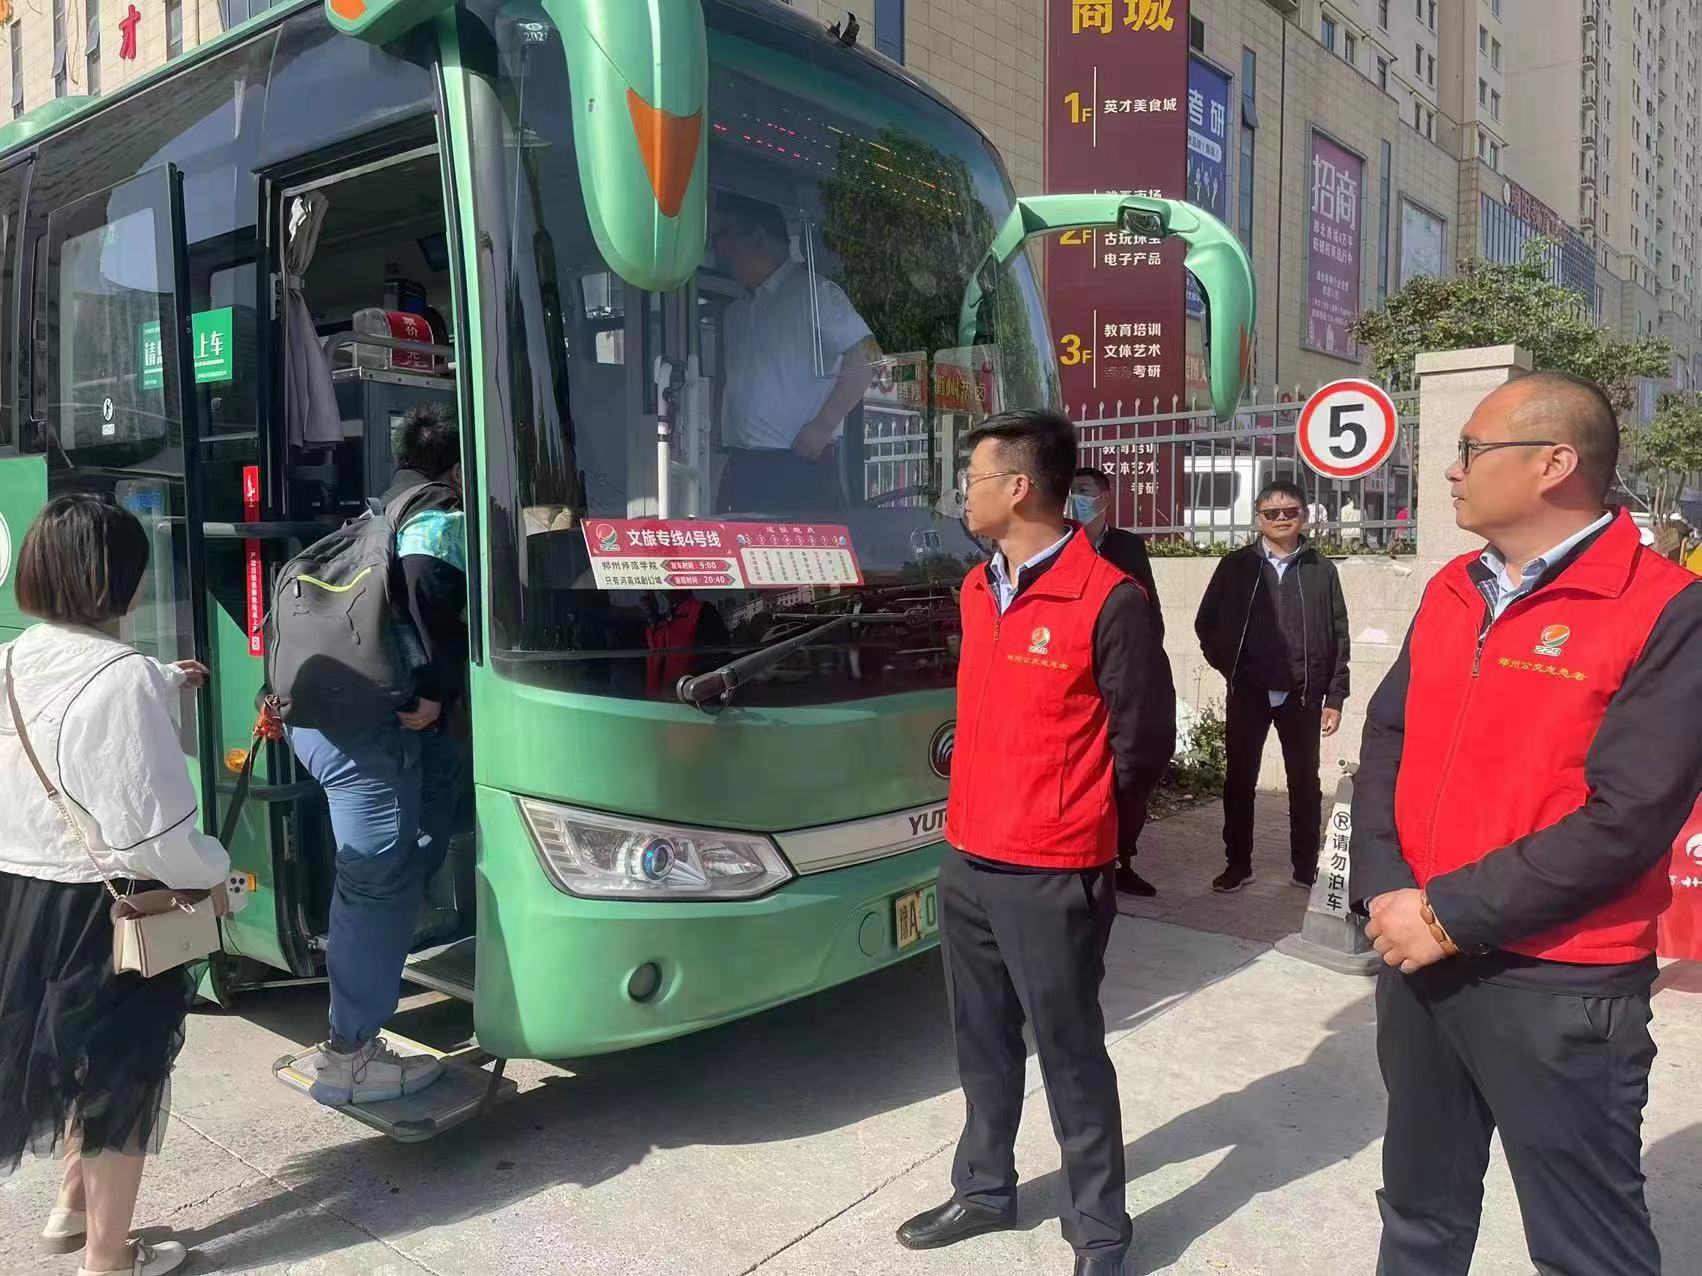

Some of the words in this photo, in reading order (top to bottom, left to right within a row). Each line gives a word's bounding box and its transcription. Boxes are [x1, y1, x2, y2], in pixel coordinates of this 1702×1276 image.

[1072, 0, 1174, 34] 商城
[1104, 97, 1177, 114] 英才美食城
[1312, 153, 1357, 231] 招商
[1104, 252, 1162, 266] 电子产品
[1104, 323, 1162, 337] 教育培训
[197, 330, 224, 359] 上车
[1104, 344, 1162, 358] 文体艺术
[1133, 365, 1161, 379] 考研
[1329, 403, 1367, 459] 5
[626, 528, 722, 548] 文旅专线4号线
[602, 561, 658, 571] 郑州师范学院
[1326, 833, 1350, 911] 请勿泊车
